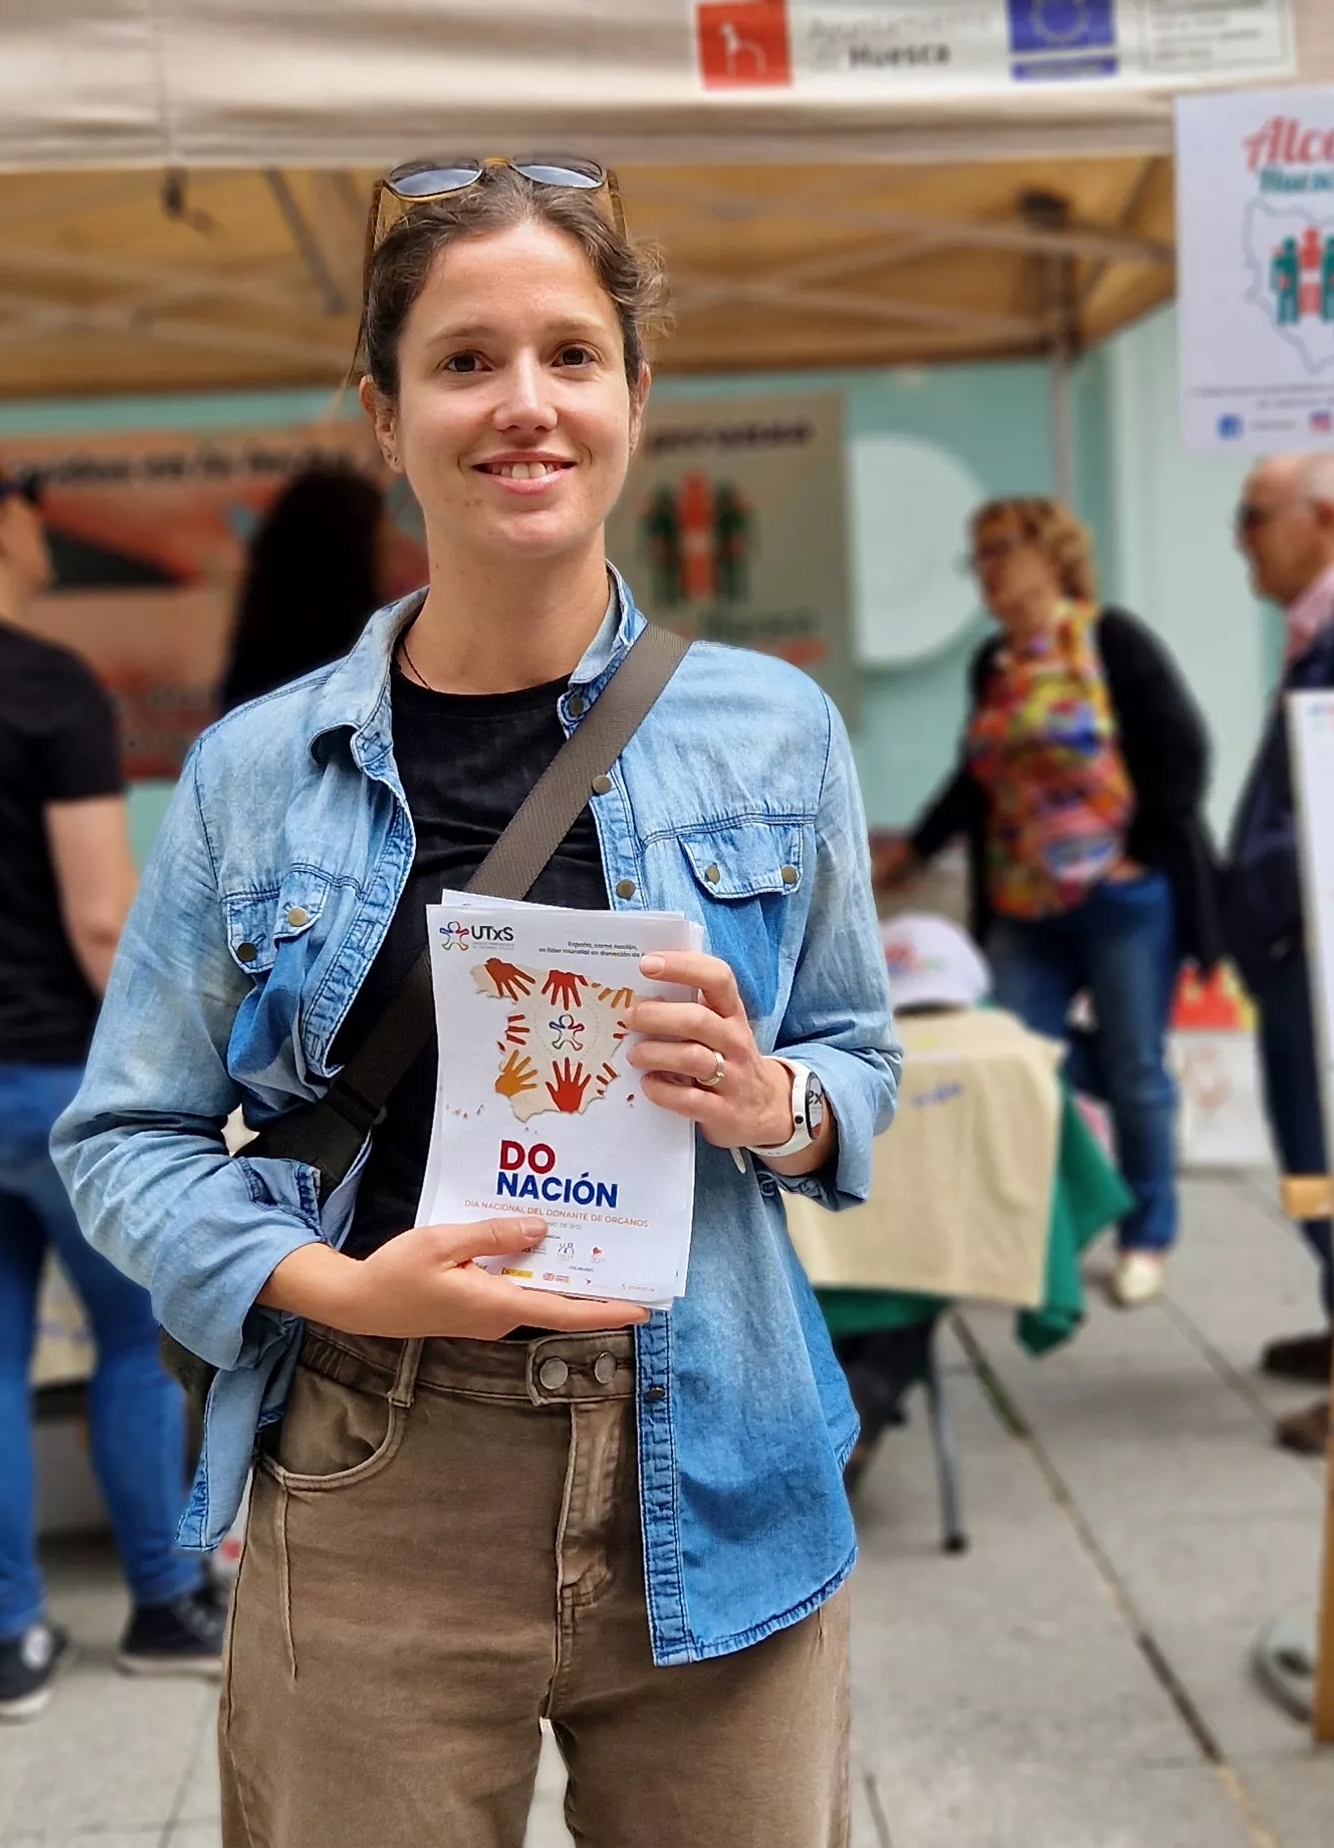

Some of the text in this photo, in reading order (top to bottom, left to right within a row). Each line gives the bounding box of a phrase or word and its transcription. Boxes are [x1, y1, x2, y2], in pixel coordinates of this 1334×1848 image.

[471, 925, 514, 941] UTxS
[500, 1140, 556, 1174] DO
[497, 1172, 618, 1208] NACIÓN
[481, 1202, 525, 1214] NACIONAL
[527, 1206, 544, 1216] DEL
[546, 1208, 588, 1221] DONANTE
[591, 1213, 603, 1222] DE
